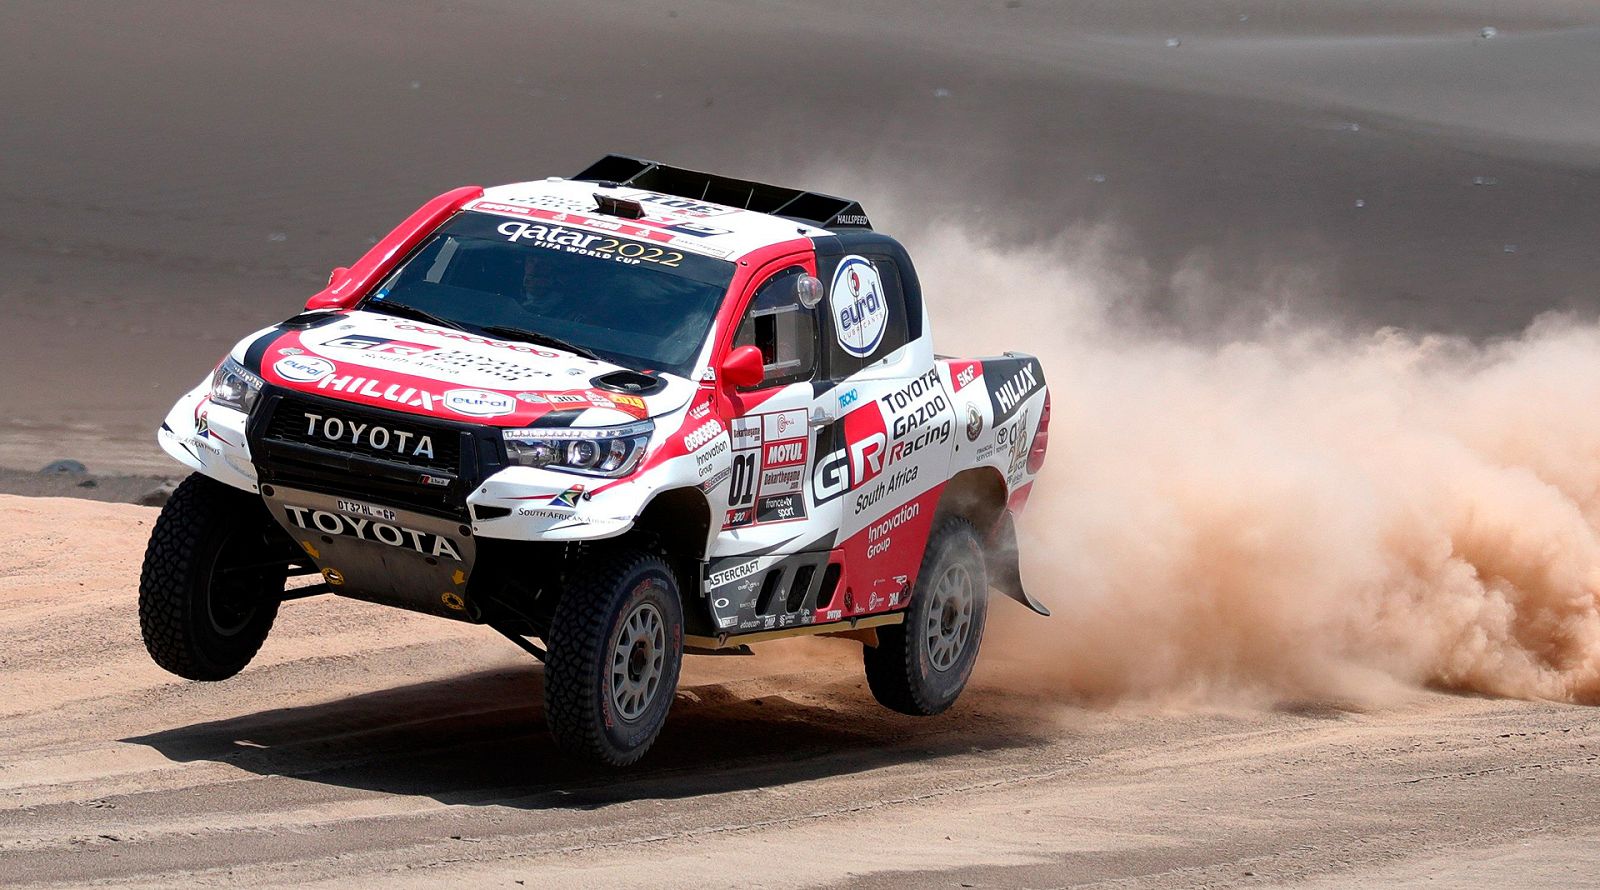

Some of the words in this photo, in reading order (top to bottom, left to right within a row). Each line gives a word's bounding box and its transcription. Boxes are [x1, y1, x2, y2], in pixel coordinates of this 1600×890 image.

[837, 214, 869, 226] HALLSPEED
[497, 221, 604, 250] qatar
[595, 237, 685, 268] 2022
[534, 240, 562, 251] FIFA
[564, 246, 613, 260] WORLD
[615, 256, 642, 266] CUP
[840, 281, 881, 331] eurol
[317, 374, 441, 411] HILUX
[882, 367, 941, 415] TOYOTA
[956, 364, 975, 388] SKF
[994, 362, 1037, 414] HILUX
[304, 412, 435, 459] TOYOTA
[893, 395, 946, 441] GAZOO
[696, 440, 728, 466] Innovation
[768, 442, 803, 465] MOTUL
[813, 431, 886, 501] GR
[889, 419, 951, 467] Racing
[698, 462, 713, 478] Group
[728, 453, 756, 507] 01
[854, 483, 886, 516] South
[886, 465, 919, 498] Africa
[284, 504, 463, 562] TOYOTA
[868, 502, 919, 543] Innovation
[867, 537, 892, 559] Group
[709, 560, 761, 588] ASTERCRAFT
